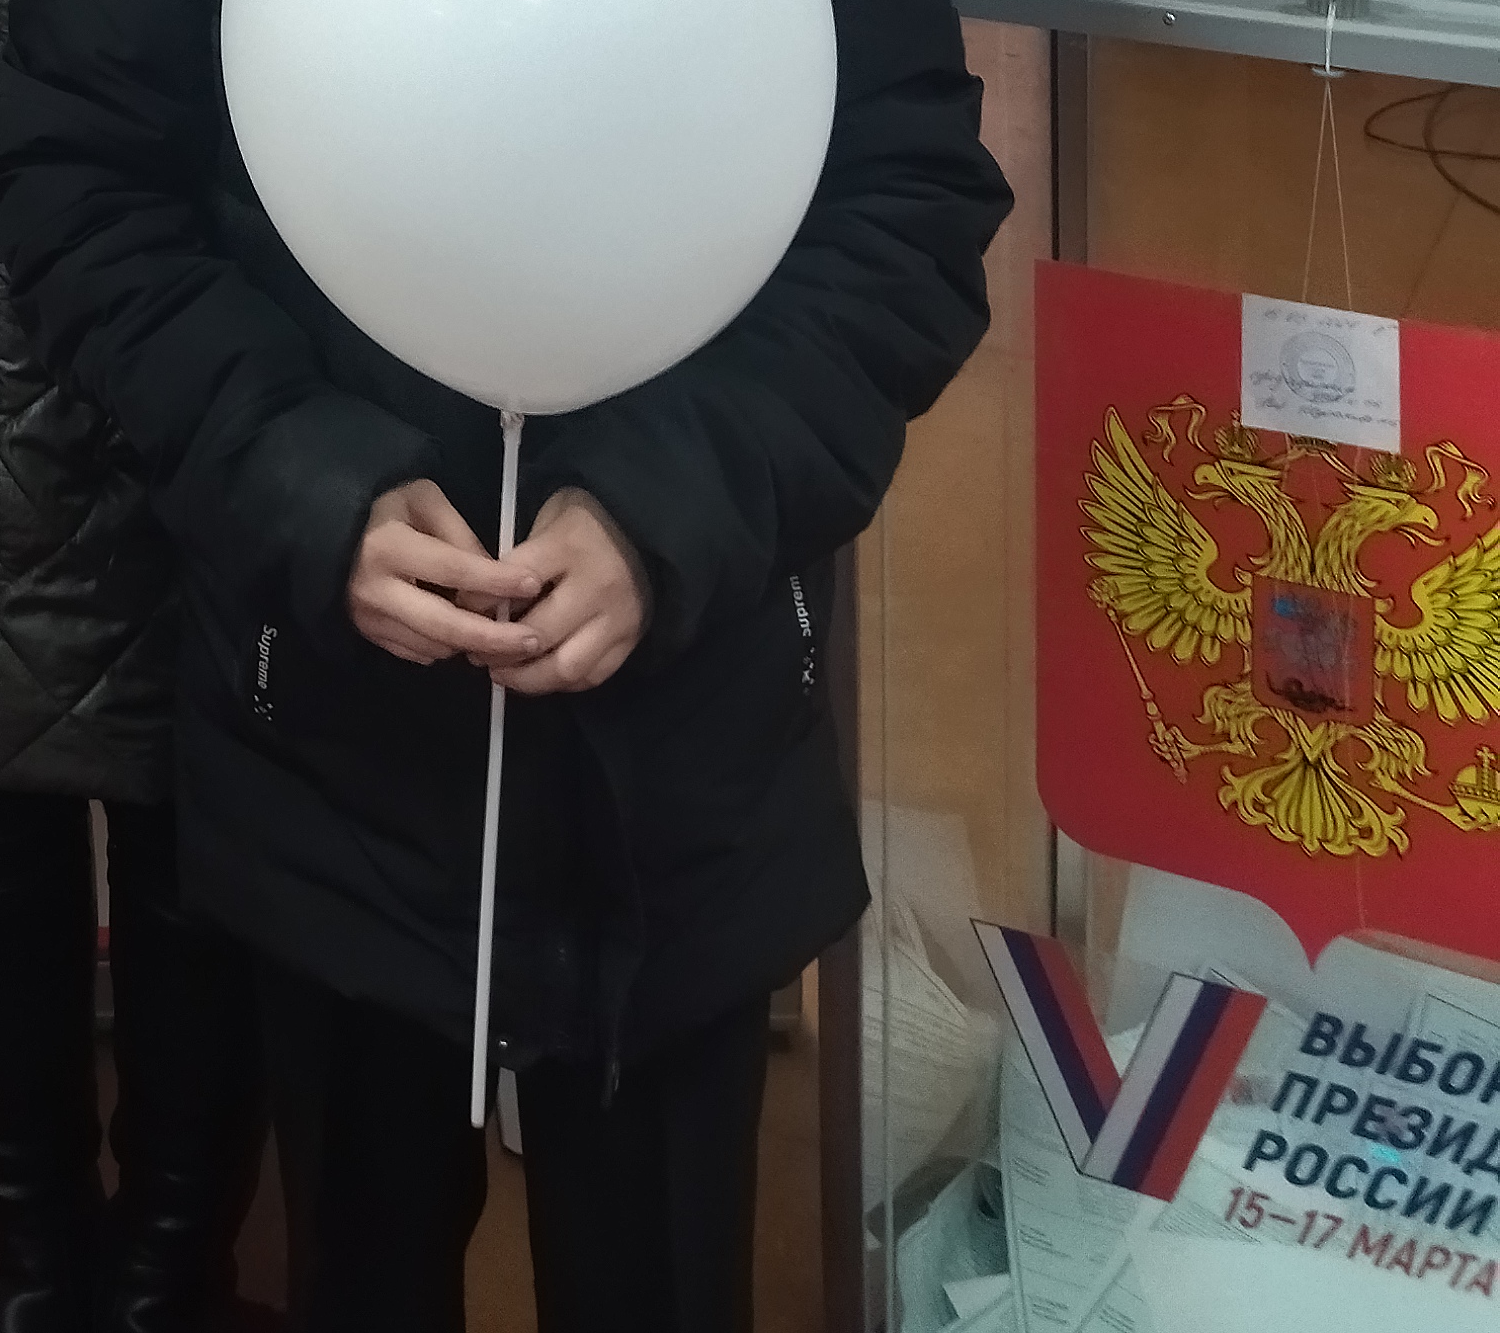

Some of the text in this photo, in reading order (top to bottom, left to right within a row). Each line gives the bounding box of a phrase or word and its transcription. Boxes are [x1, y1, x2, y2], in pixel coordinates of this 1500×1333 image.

[258, 624, 278, 690] Supreme
[1243, 1129, 1500, 1237] РОССИИ
[1346, 1223, 1500, 1297] МАРТА
